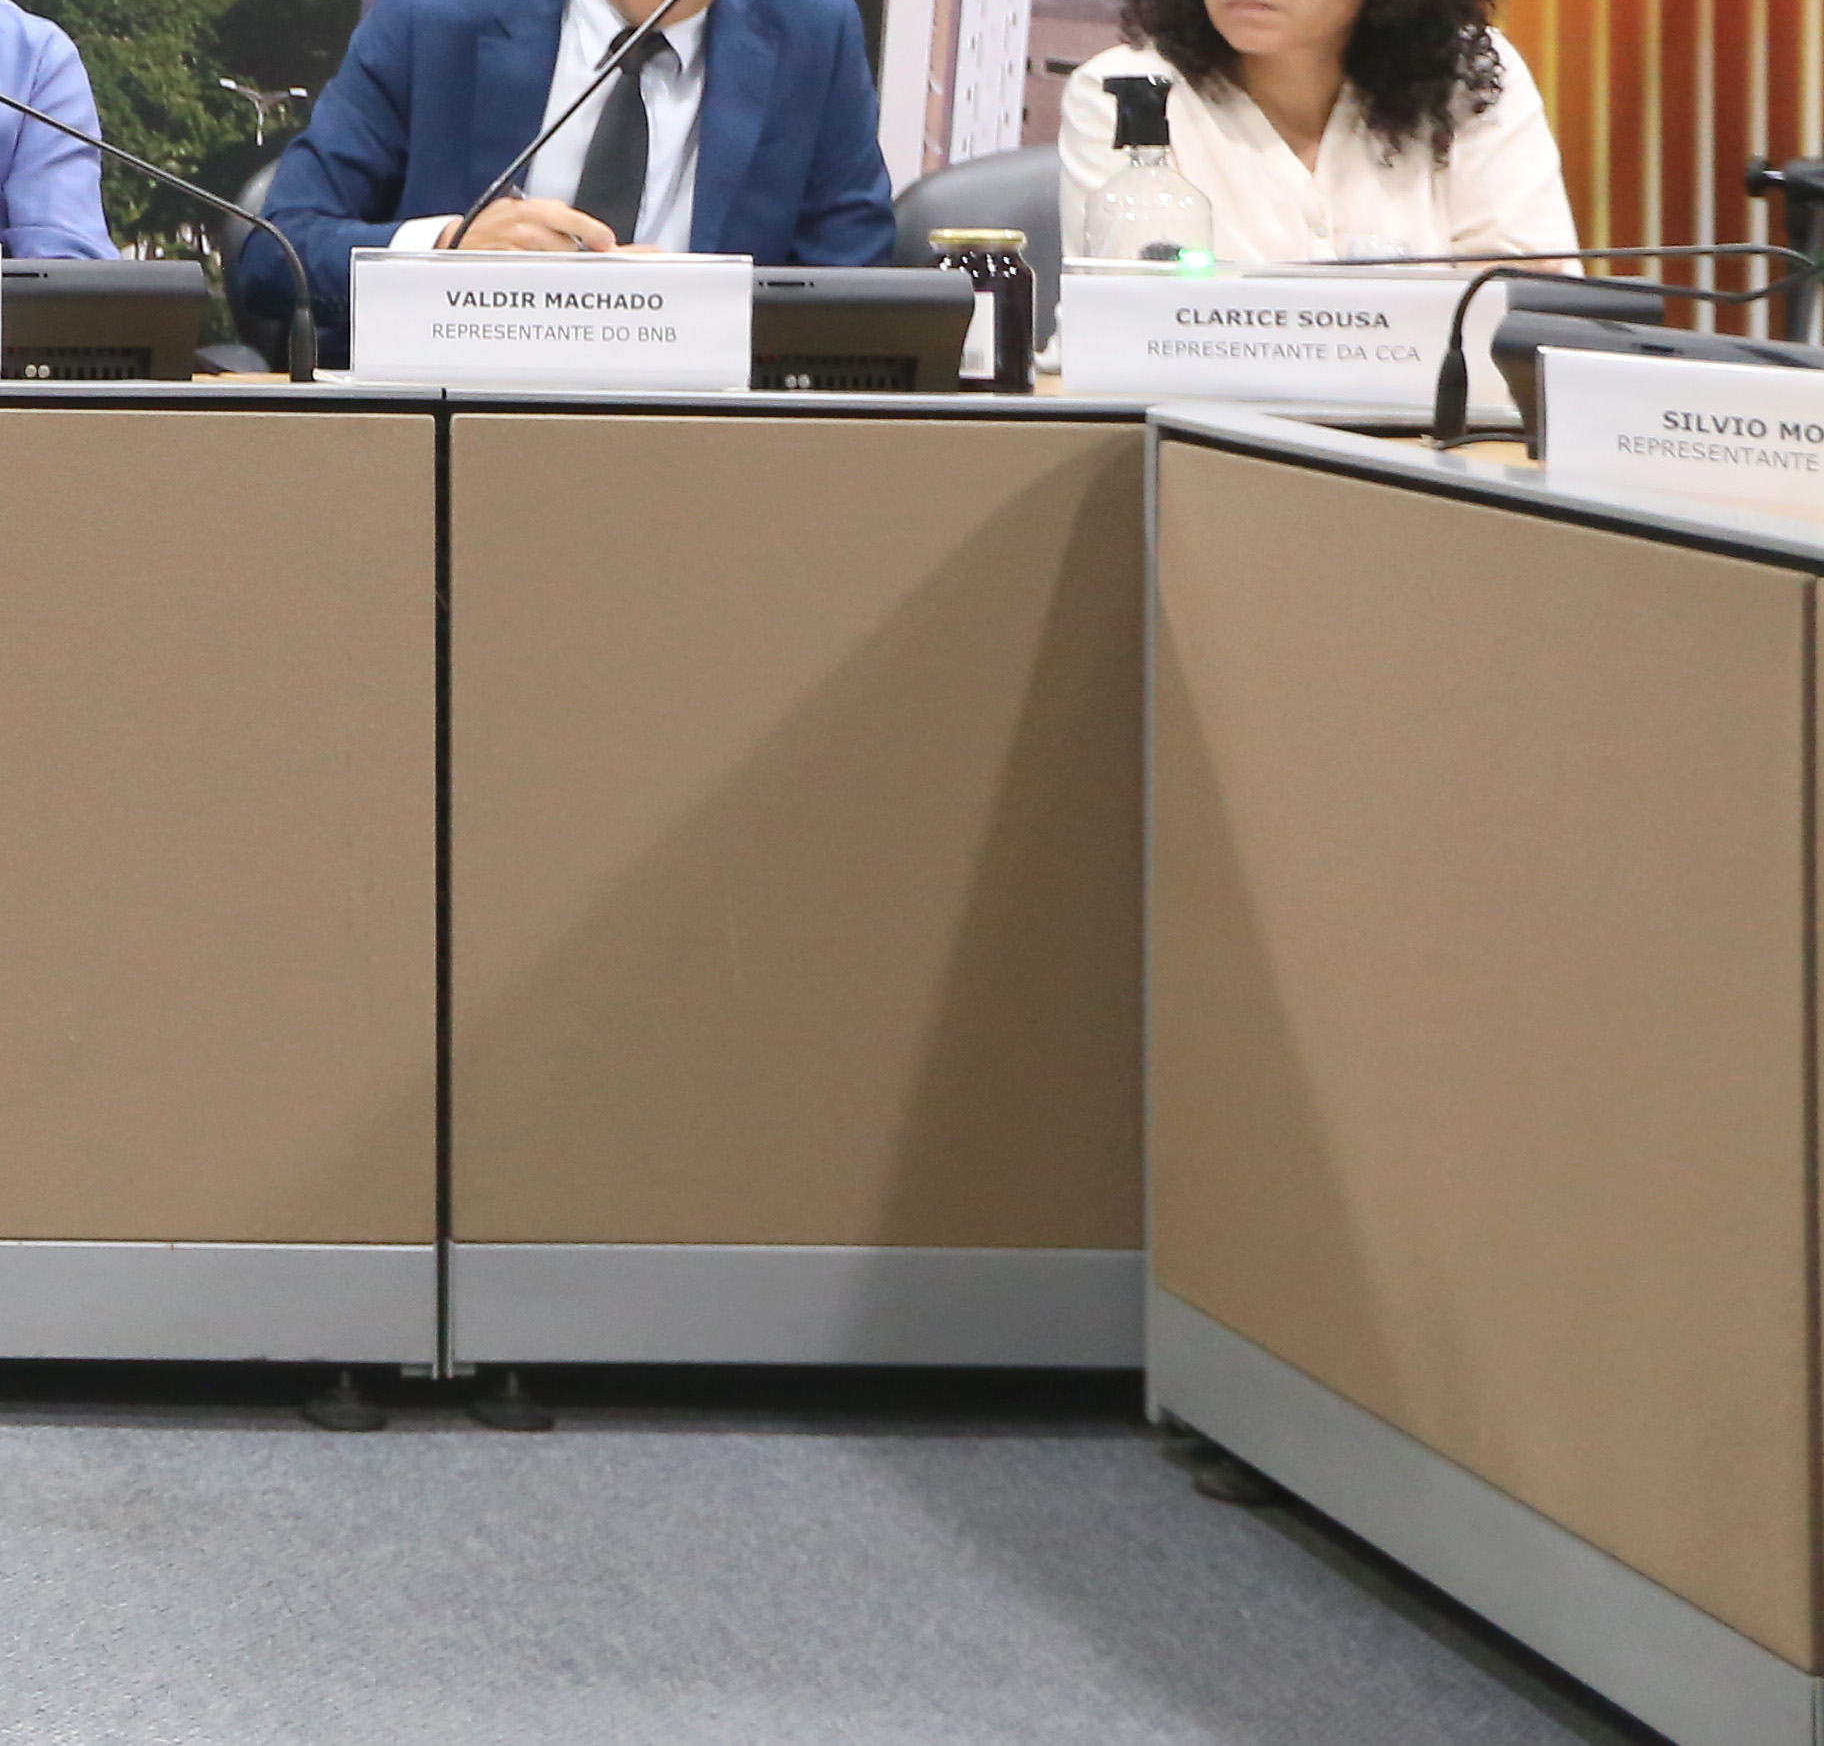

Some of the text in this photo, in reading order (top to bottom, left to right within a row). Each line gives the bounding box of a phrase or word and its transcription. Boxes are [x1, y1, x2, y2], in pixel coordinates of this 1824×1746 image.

[446, 291, 663, 310] VALDIR MACHADO
[1176, 308, 1389, 328] CLARICE SOUSA
[433, 323, 677, 342] REPRESENTANTE DO BNB
[1148, 340, 1421, 362] REPRESENTANTE DA CCA
[1663, 411, 1767, 438] SILVIO
[1617, 434, 1820, 472] REPRESENTANTE
